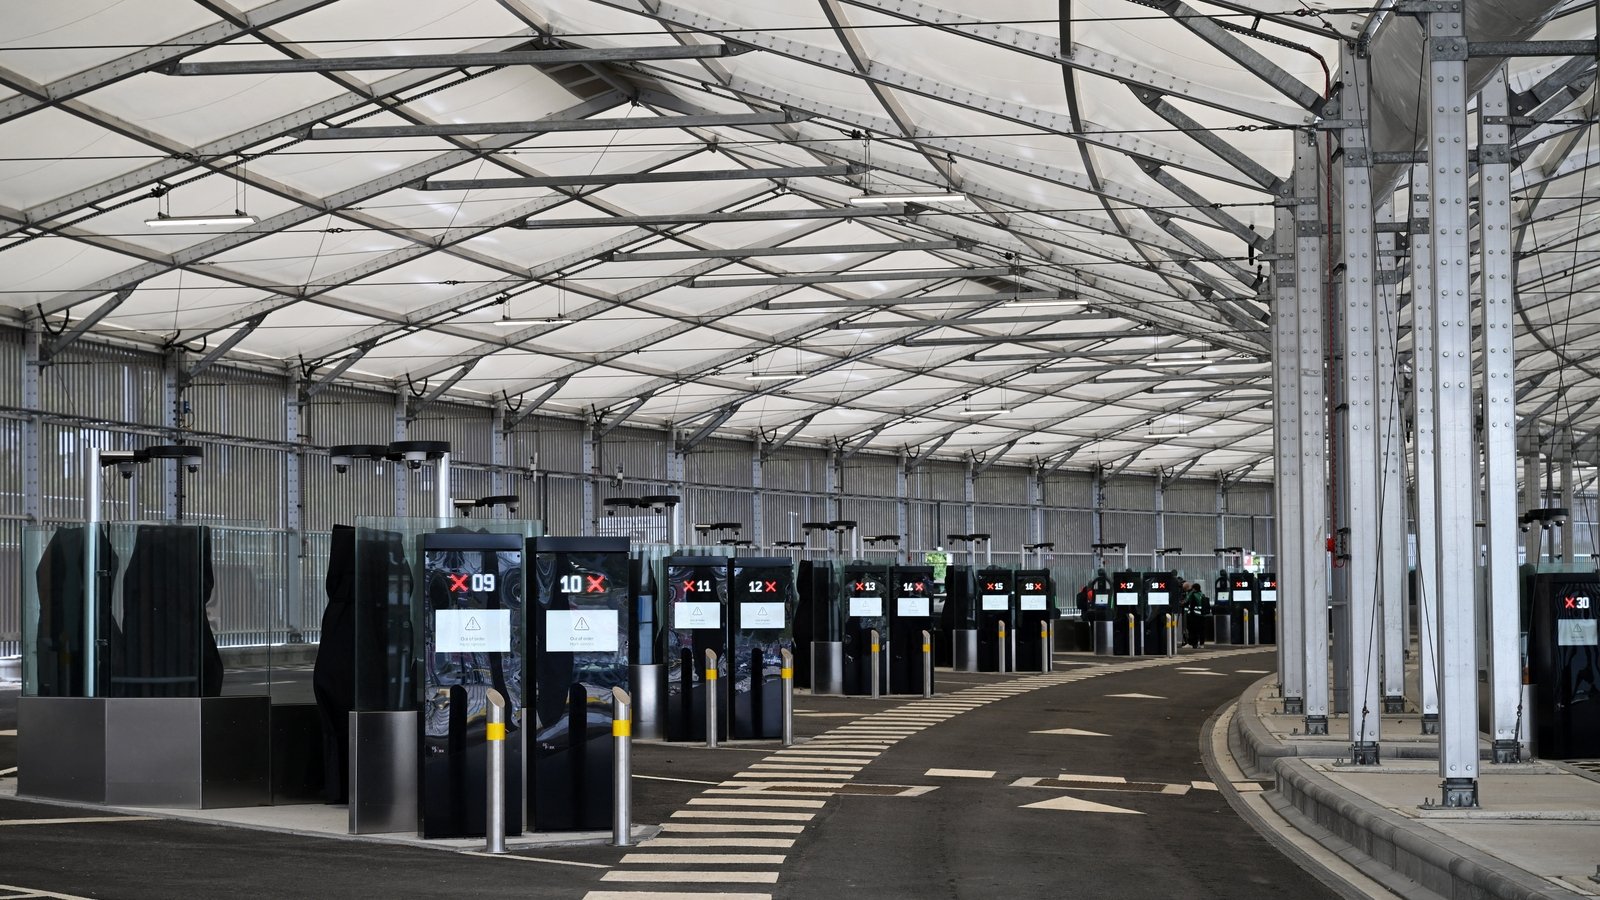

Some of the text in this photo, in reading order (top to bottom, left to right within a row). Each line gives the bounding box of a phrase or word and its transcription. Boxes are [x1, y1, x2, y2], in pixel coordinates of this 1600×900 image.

[472, 573, 495, 592] 09
[560, 575, 582, 593] 10
[696, 580, 711, 592] 11
[748, 580, 763, 593] 12
[865, 582, 876, 591] 13
[903, 582, 914, 591] 14
[994, 583, 1003, 591] 15
[1025, 583, 1034, 591] 16
[1576, 597, 1590, 609] 30
